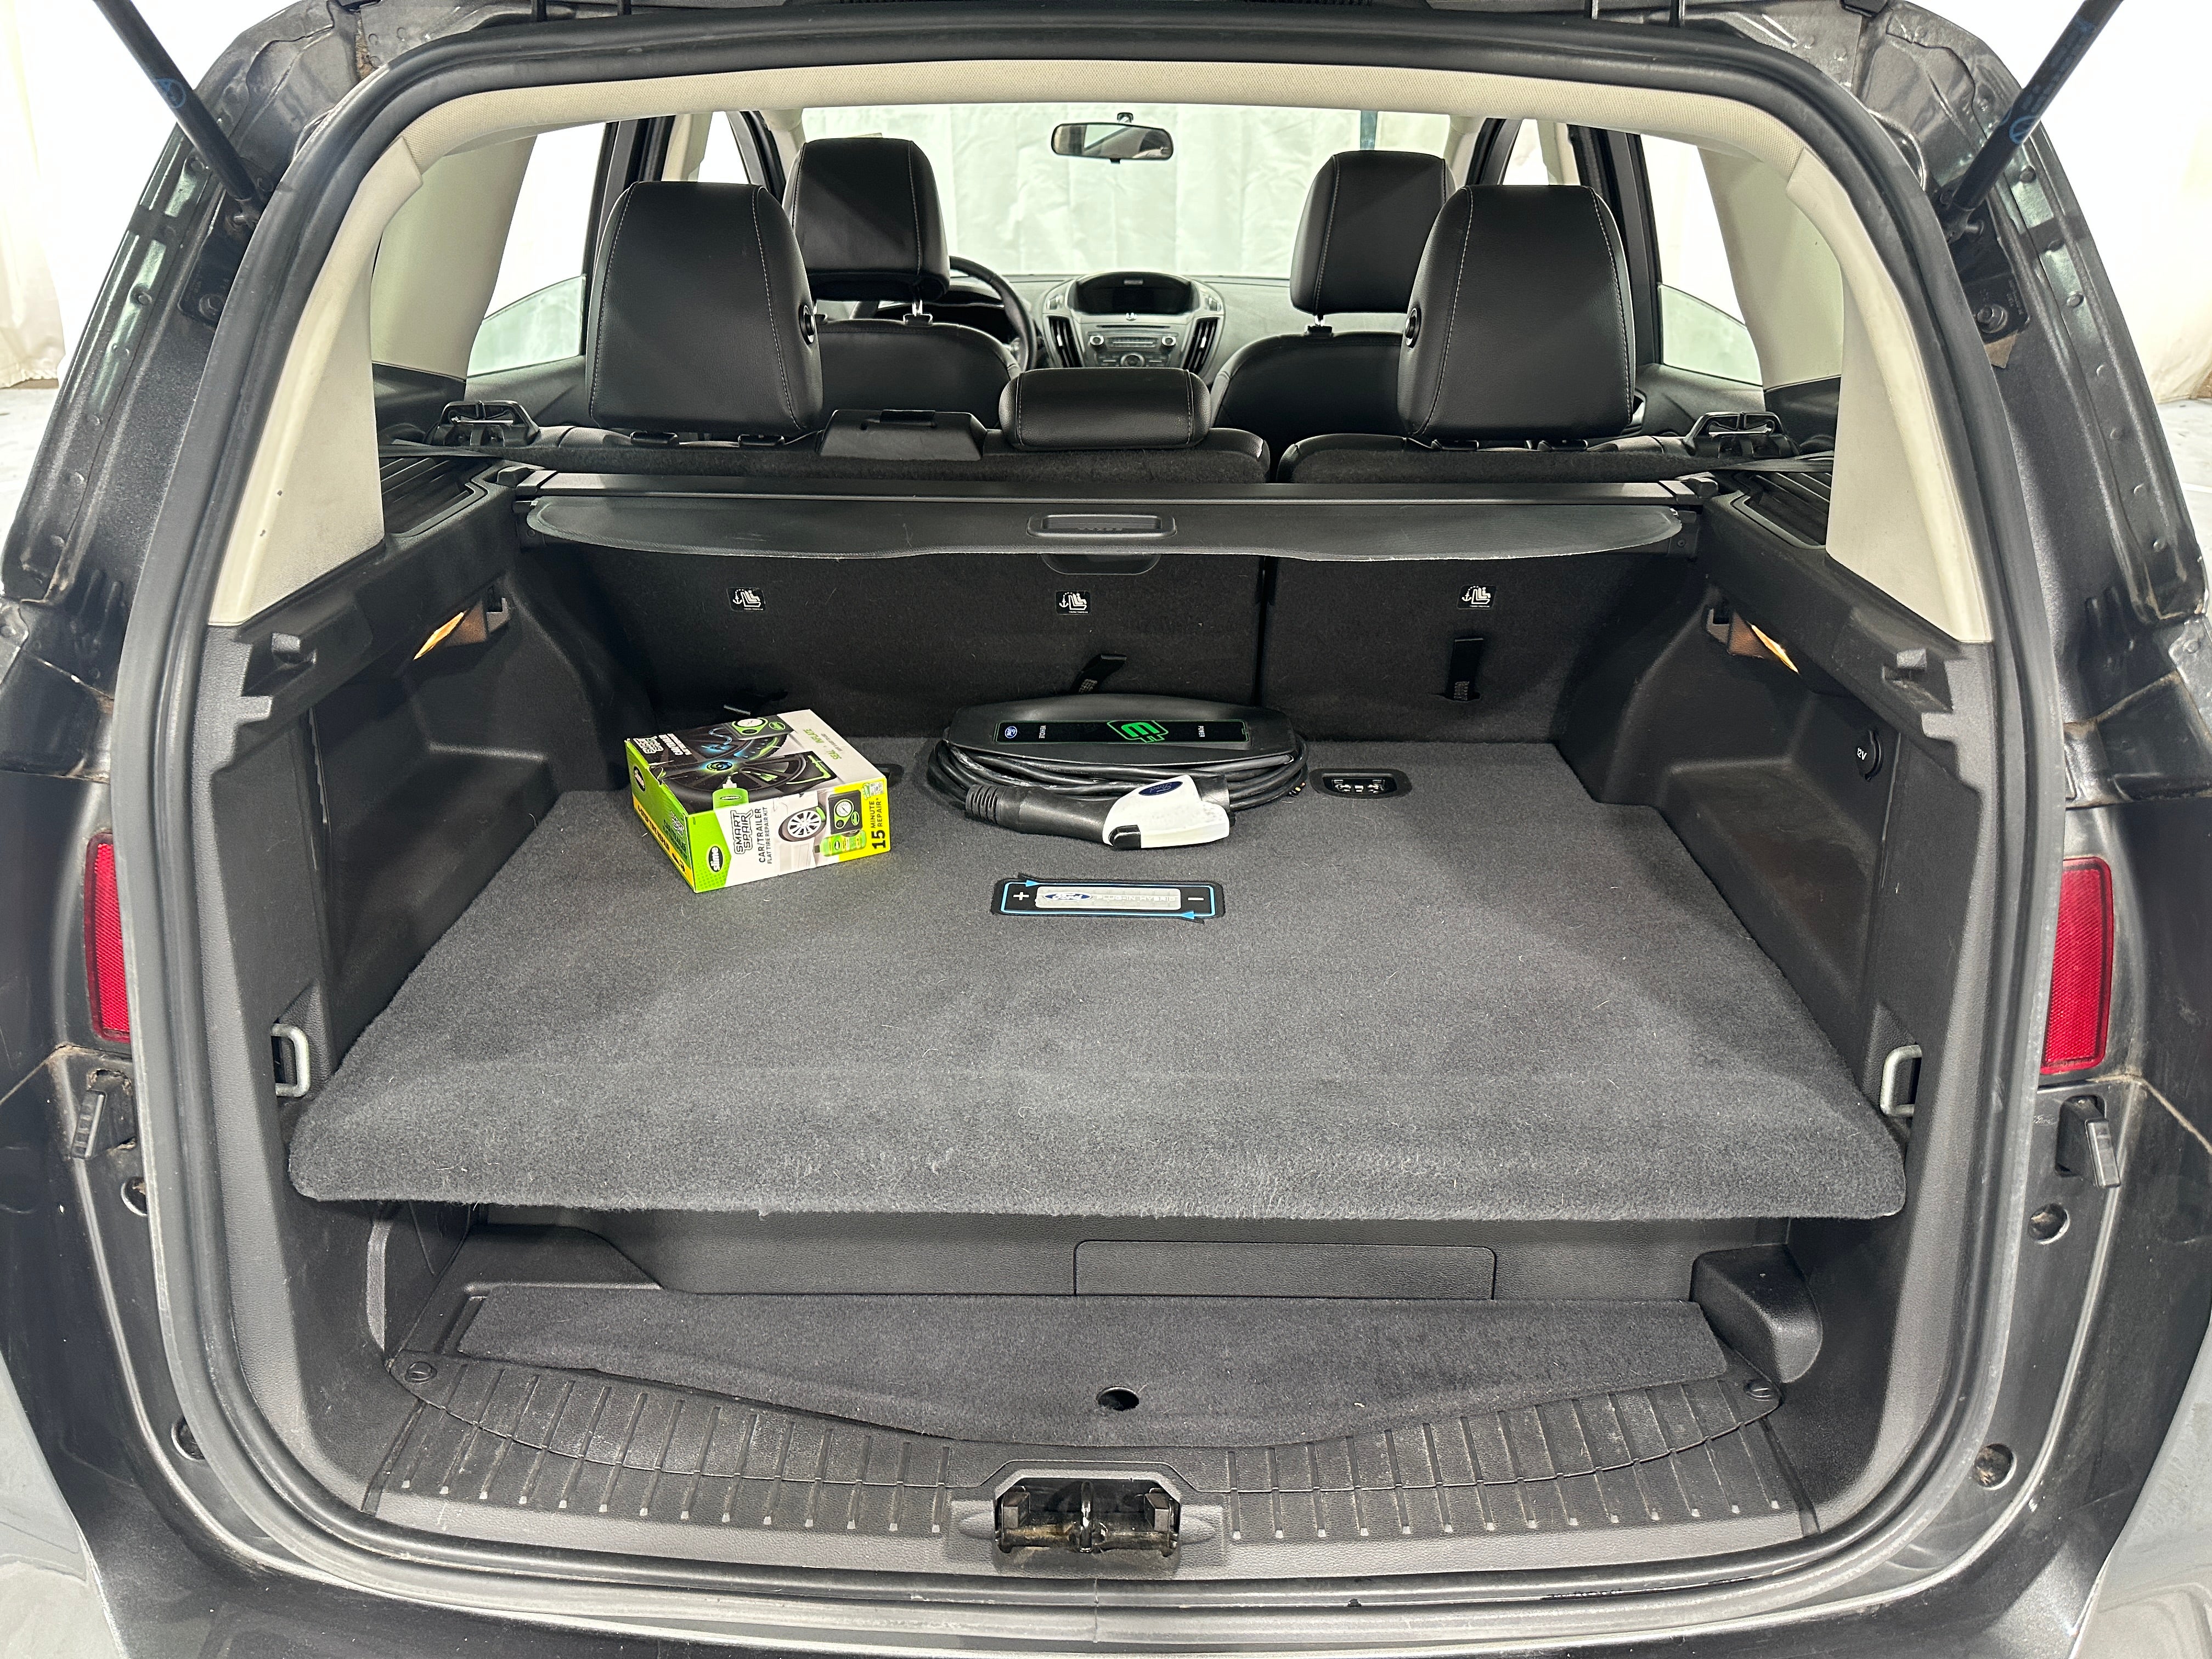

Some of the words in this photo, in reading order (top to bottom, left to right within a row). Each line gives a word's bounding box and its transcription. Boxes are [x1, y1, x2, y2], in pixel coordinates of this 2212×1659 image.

[1149, 782, 1172, 793] Ford
[732, 812, 743, 853] SMART
[741, 812, 751, 849] SPAIR
[754, 808, 766, 863] CAR/TRAILER
[871, 830, 886, 849] 15
[710, 847, 720, 871] slime
